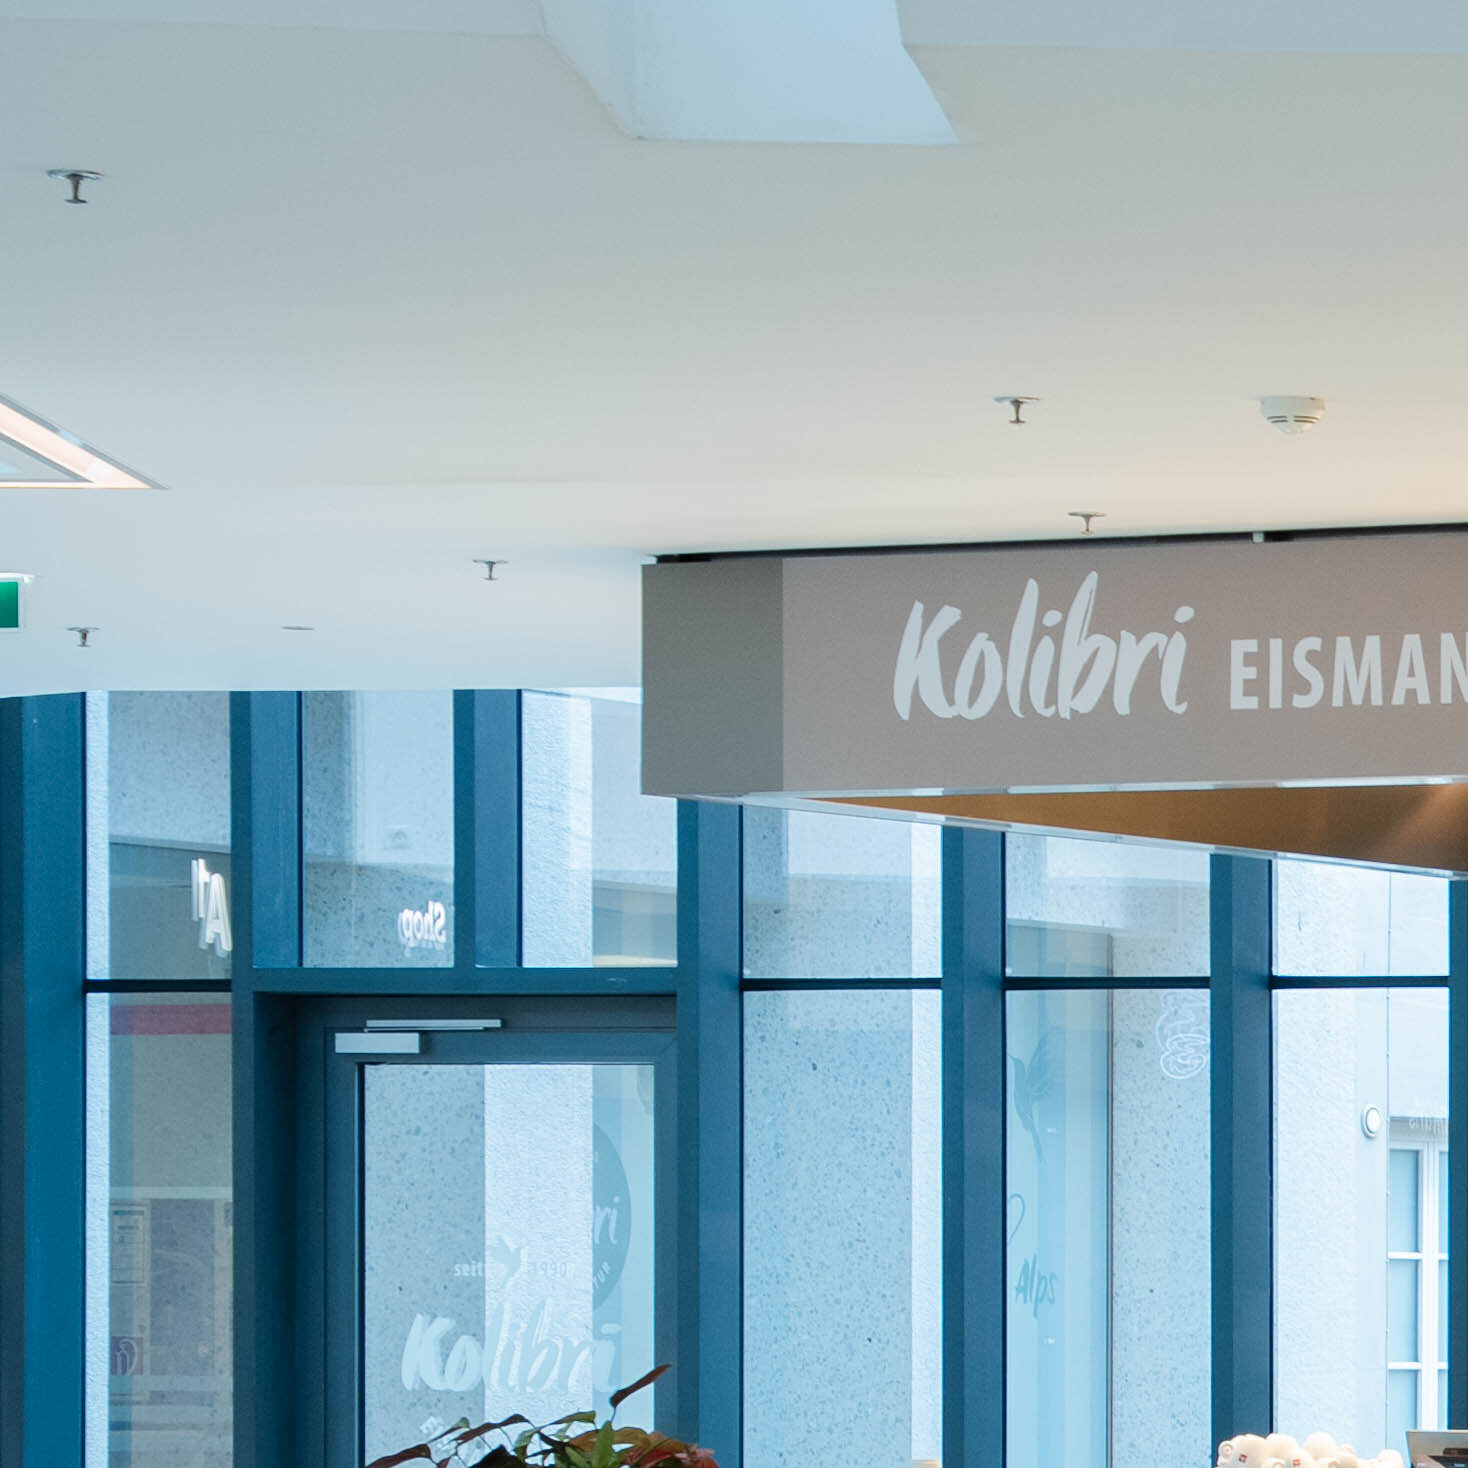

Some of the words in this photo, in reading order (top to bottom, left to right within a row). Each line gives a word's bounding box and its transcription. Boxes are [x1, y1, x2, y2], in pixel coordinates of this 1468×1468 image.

[893, 571, 1195, 721] Kolibri
[1015, 1253, 1057, 1320] Alps
[401, 1298, 622, 1392] Kolibri
